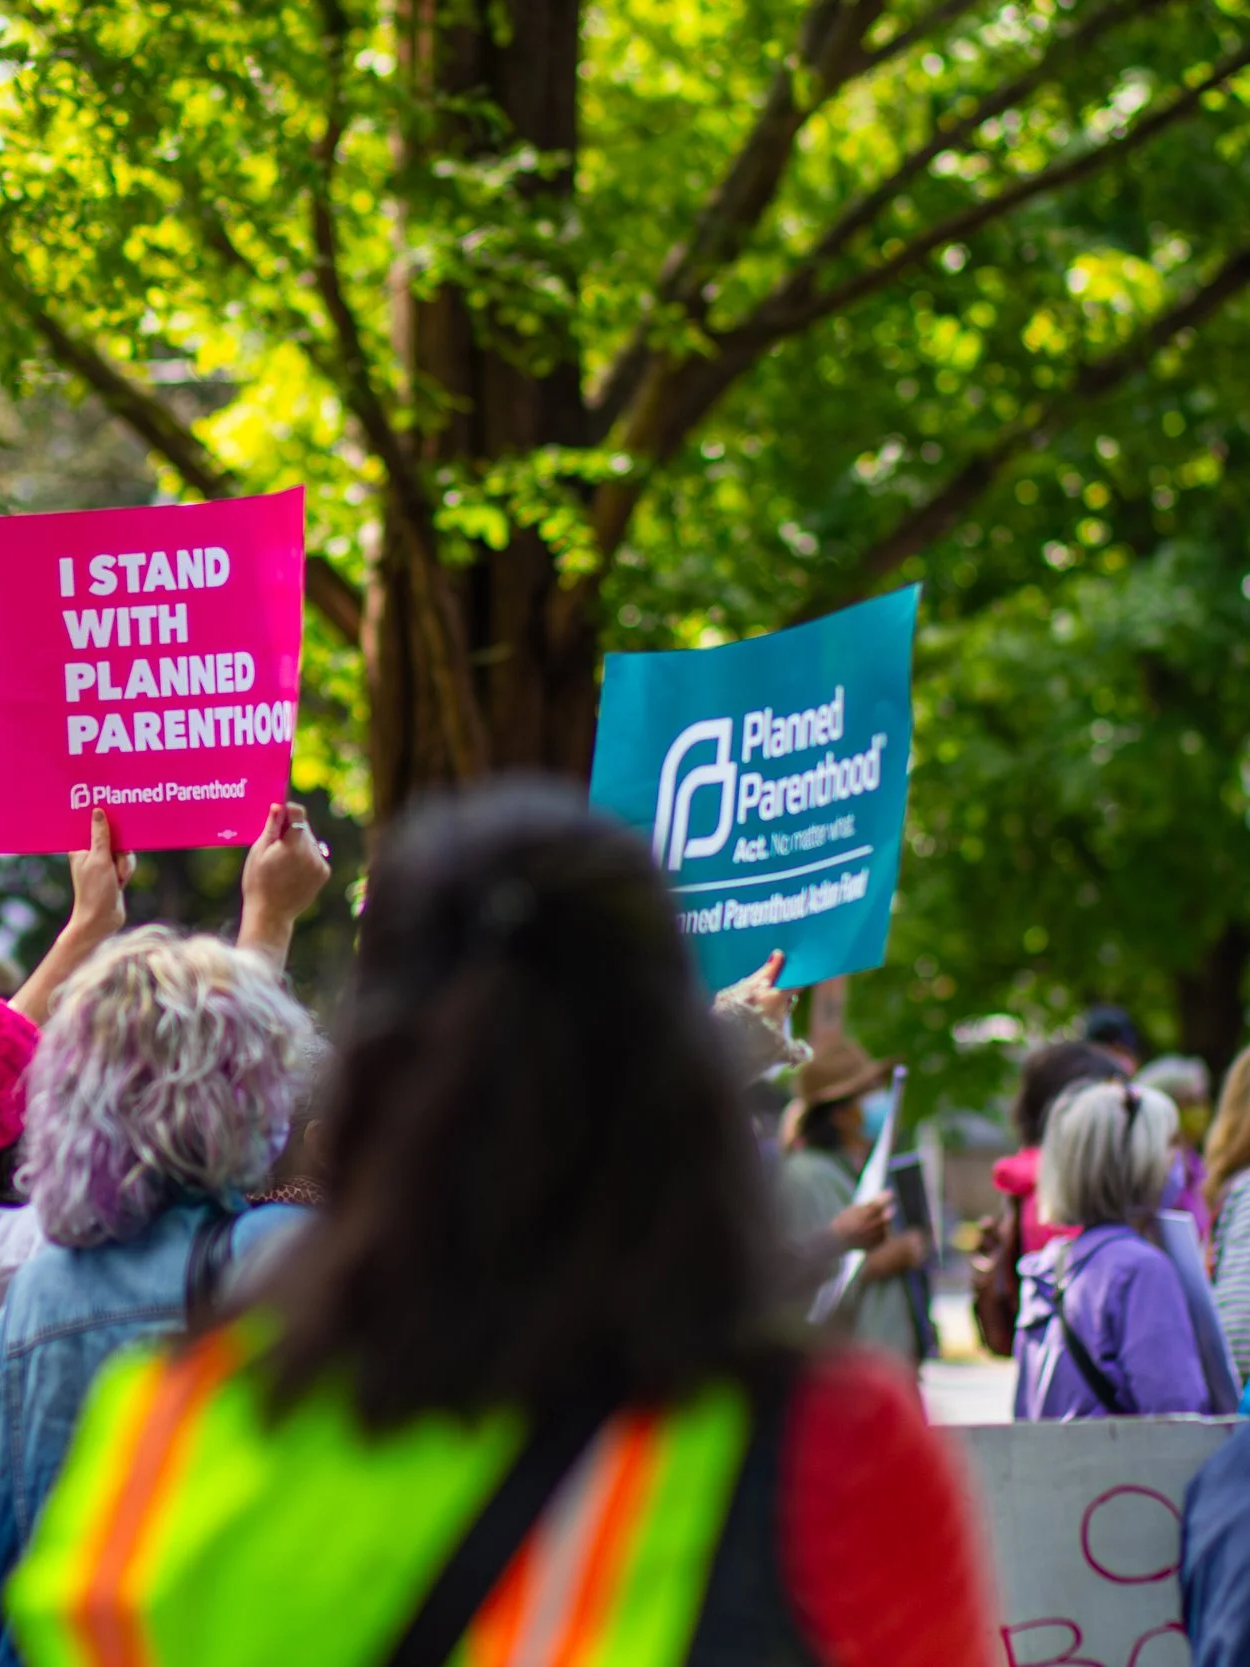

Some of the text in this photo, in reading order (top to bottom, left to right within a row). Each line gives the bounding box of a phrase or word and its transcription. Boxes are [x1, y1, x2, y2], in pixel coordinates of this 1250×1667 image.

[59, 546, 230, 598] I STAND
[62, 602, 189, 650] WITH
[64, 651, 255, 703] PLANNED
[742, 684, 844, 763] Planned
[92, 779, 246, 806] Planned Parenthood
[737, 734, 882, 825] Parenthood
[732, 834, 770, 865] Act.
[771, 831, 792, 857] No
